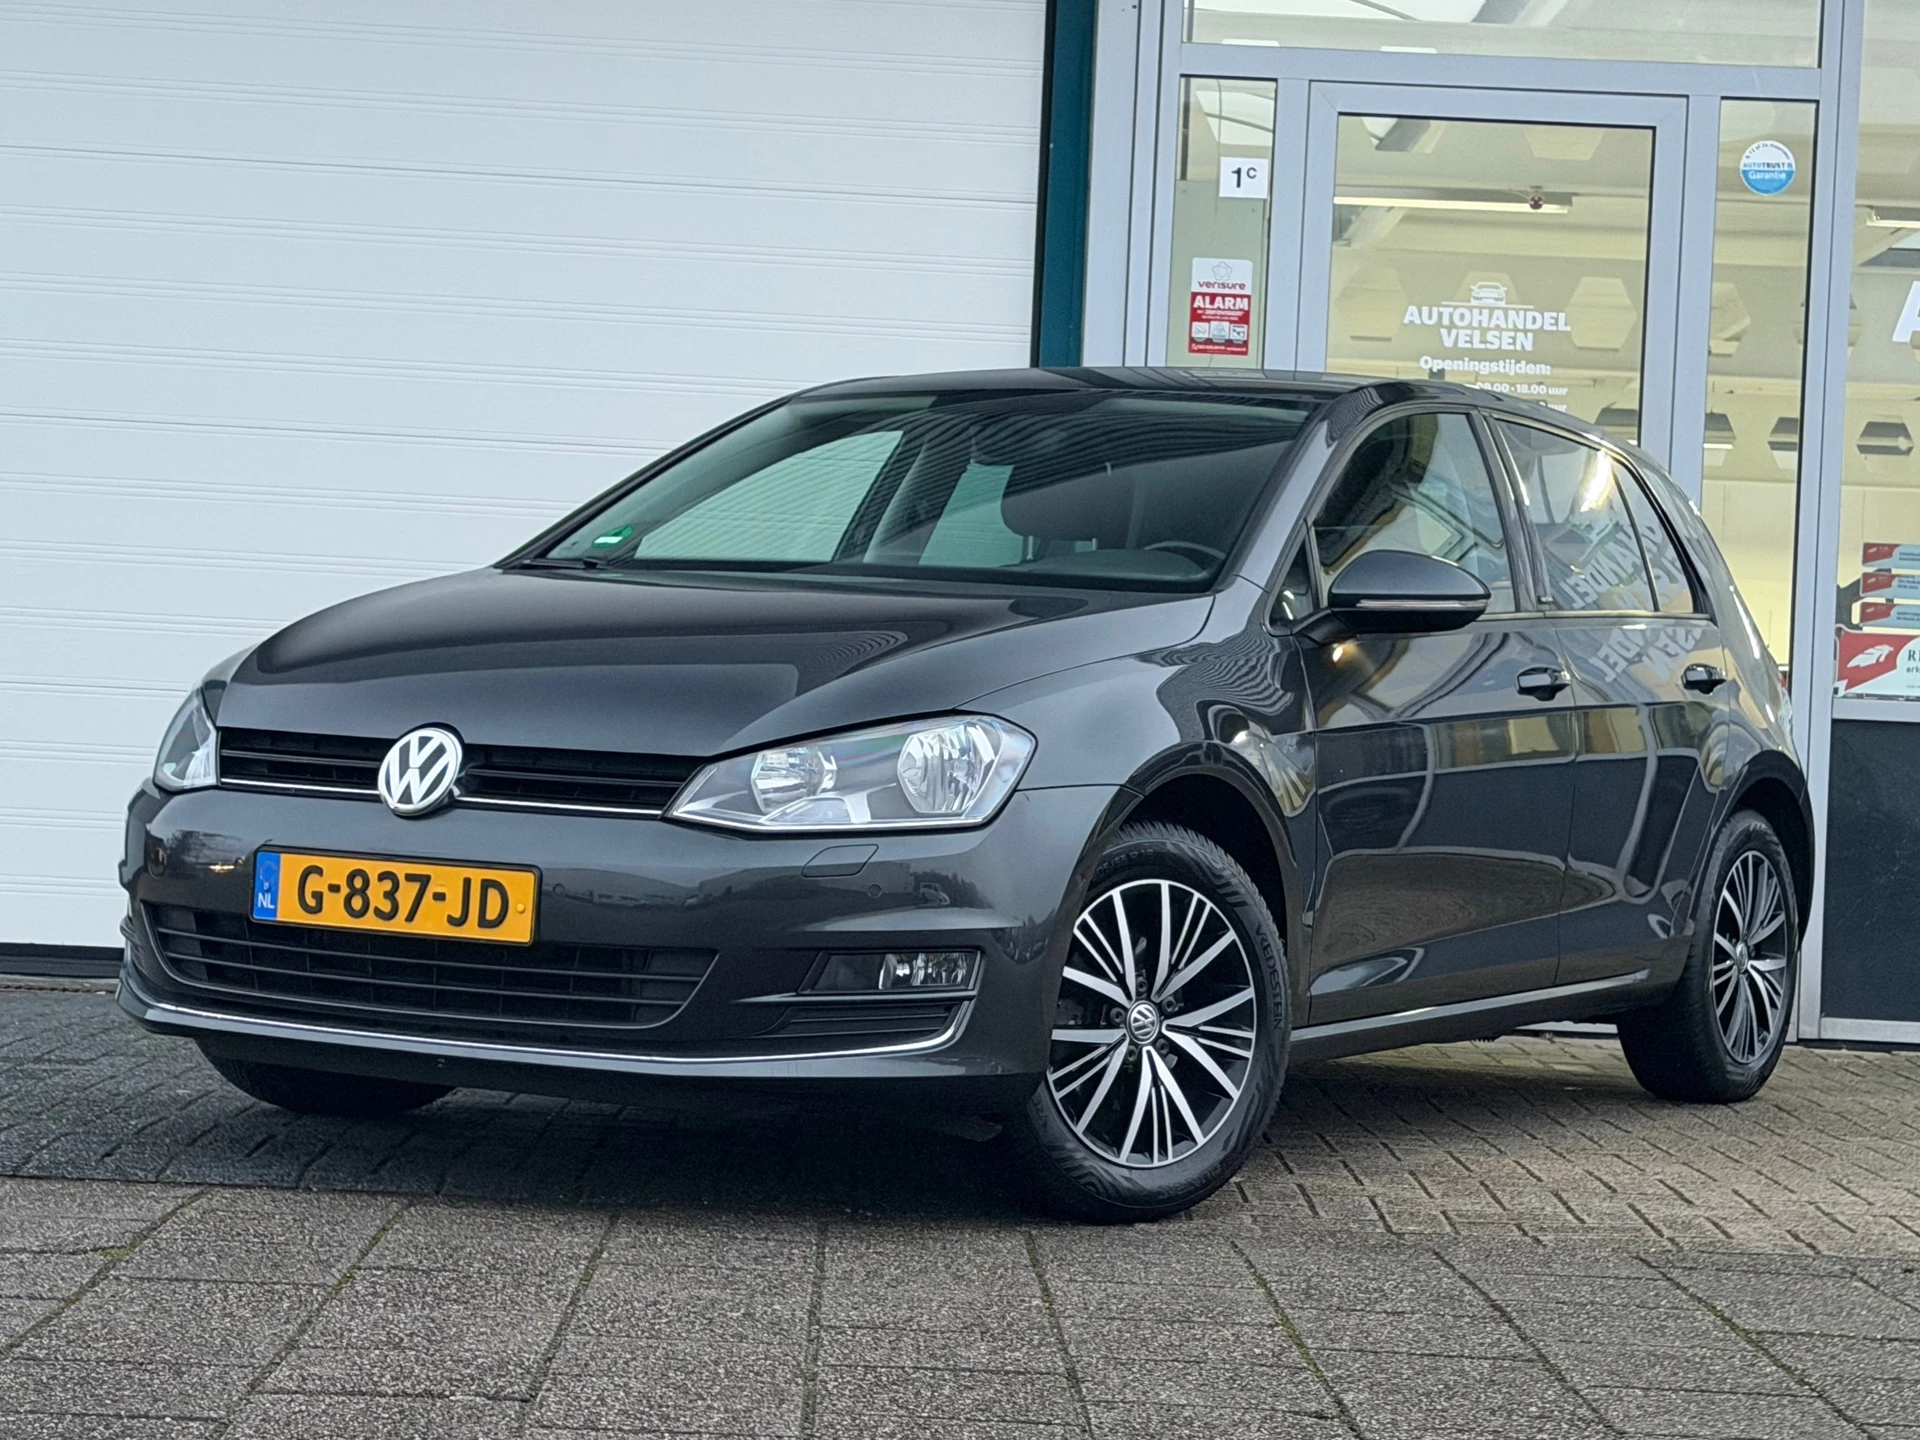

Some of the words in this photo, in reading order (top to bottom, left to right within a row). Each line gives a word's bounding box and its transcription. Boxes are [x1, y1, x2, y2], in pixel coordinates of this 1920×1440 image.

[1198, 281, 1246, 290] verisure
[1193, 295, 1249, 311] ALARM
[1403, 305, 1571, 332] AUTOHANDEL
[1440, 328, 1534, 351] VELSEN
[1419, 355, 1551, 376] Openingstijden:
[1548, 386, 1568, 396] uur
[257, 892, 275, 909] NL
[297, 865, 510, 929] G-837-JD
